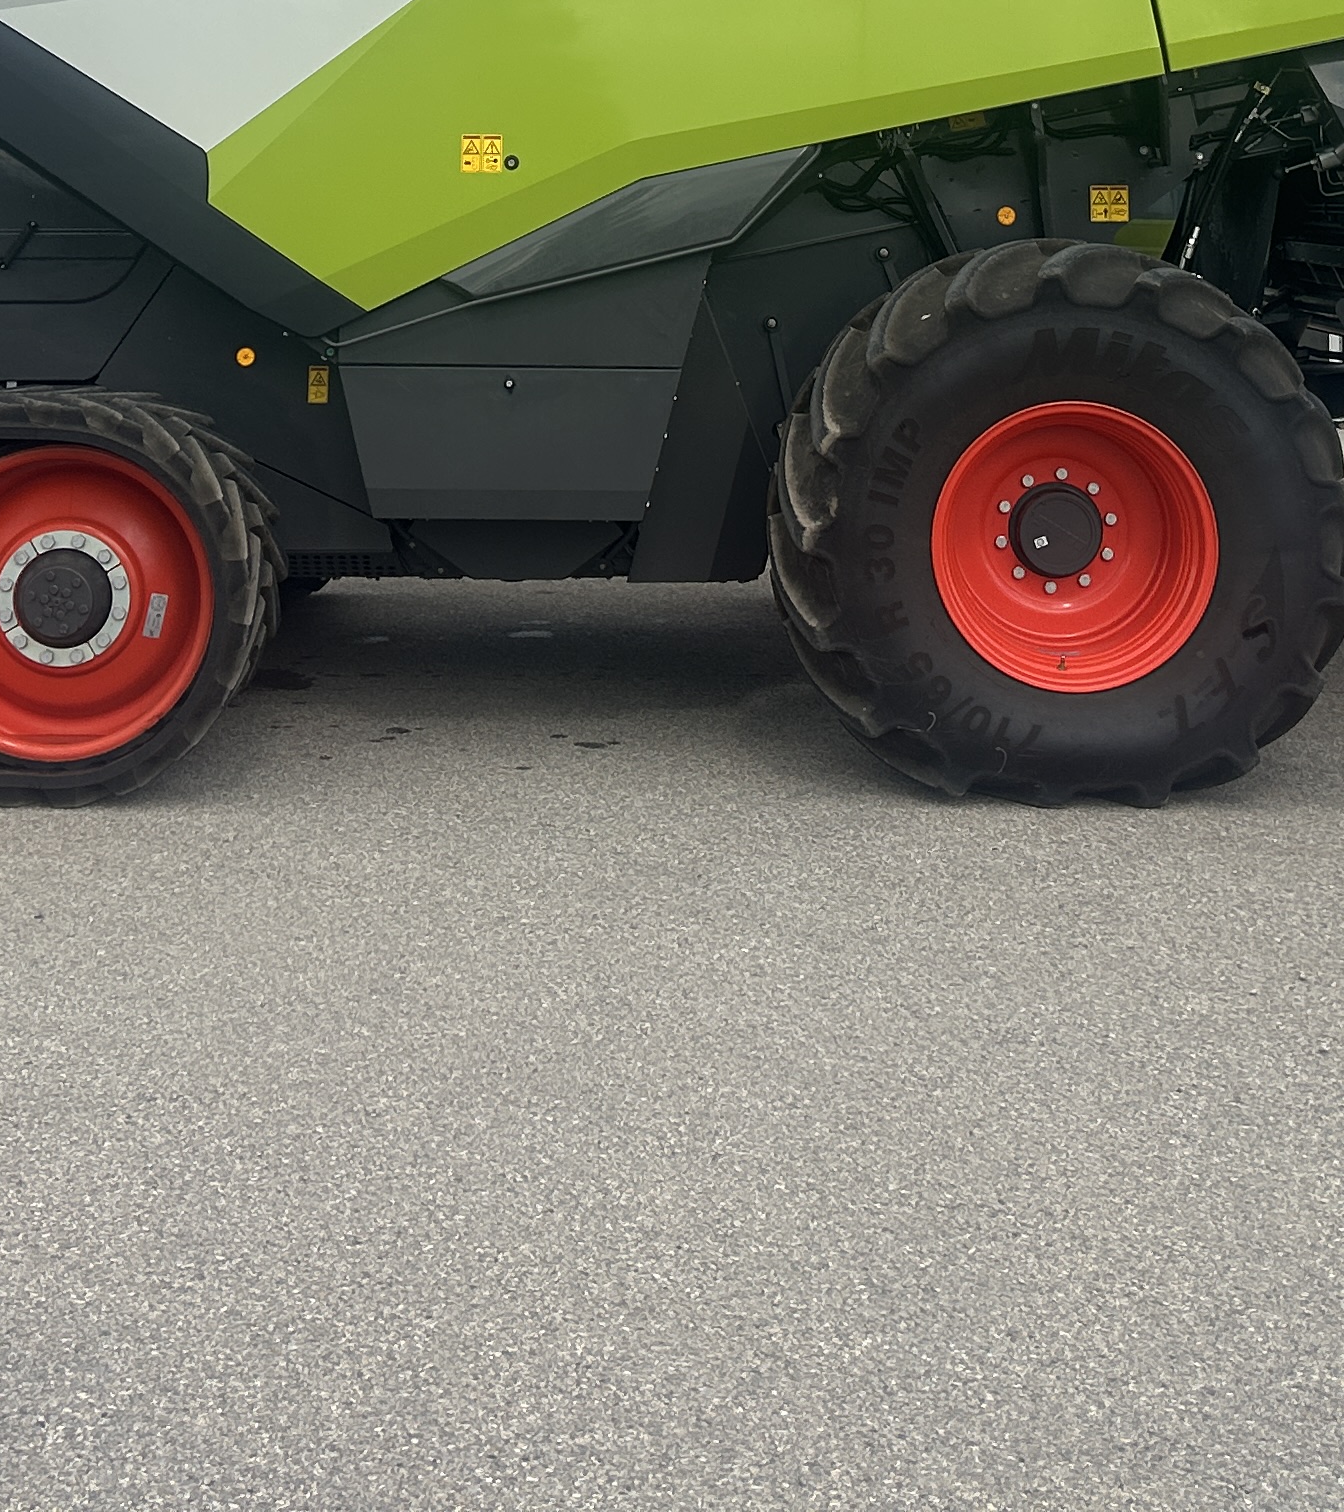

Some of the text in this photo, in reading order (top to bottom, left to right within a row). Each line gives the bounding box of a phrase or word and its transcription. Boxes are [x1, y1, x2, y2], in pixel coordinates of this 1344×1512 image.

[867, 417, 923, 509] IMP
[862, 524, 897, 584] 30
[873, 600, 910, 635] R
